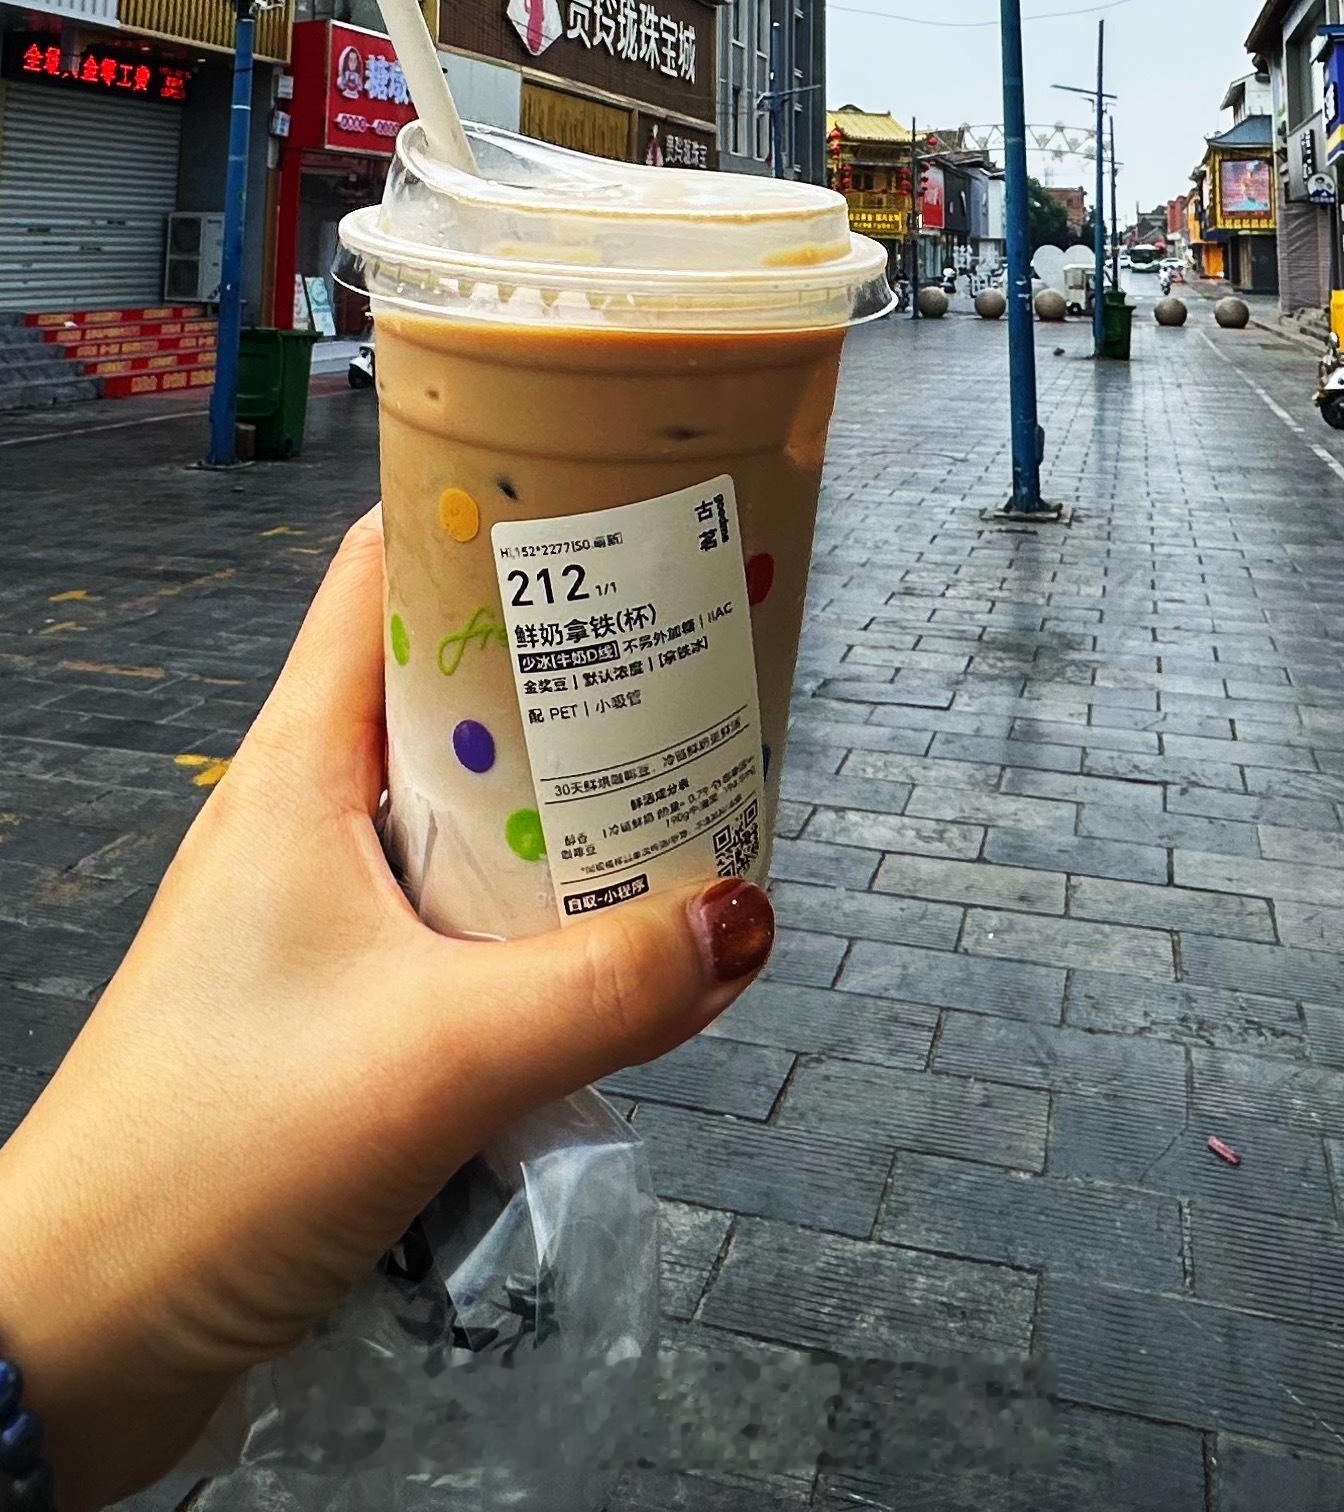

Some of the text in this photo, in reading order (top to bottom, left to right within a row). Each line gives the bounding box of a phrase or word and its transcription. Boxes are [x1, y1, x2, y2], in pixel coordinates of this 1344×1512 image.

[507, 563, 618, 607] 212 1/1
[514, 603, 657, 649] 鲜奶拿铁(杯)
[582, 659, 645, 688] 默认浓度
[549, 704, 579, 721] PET
[567, 876, 646, 913] 自取-小程序
